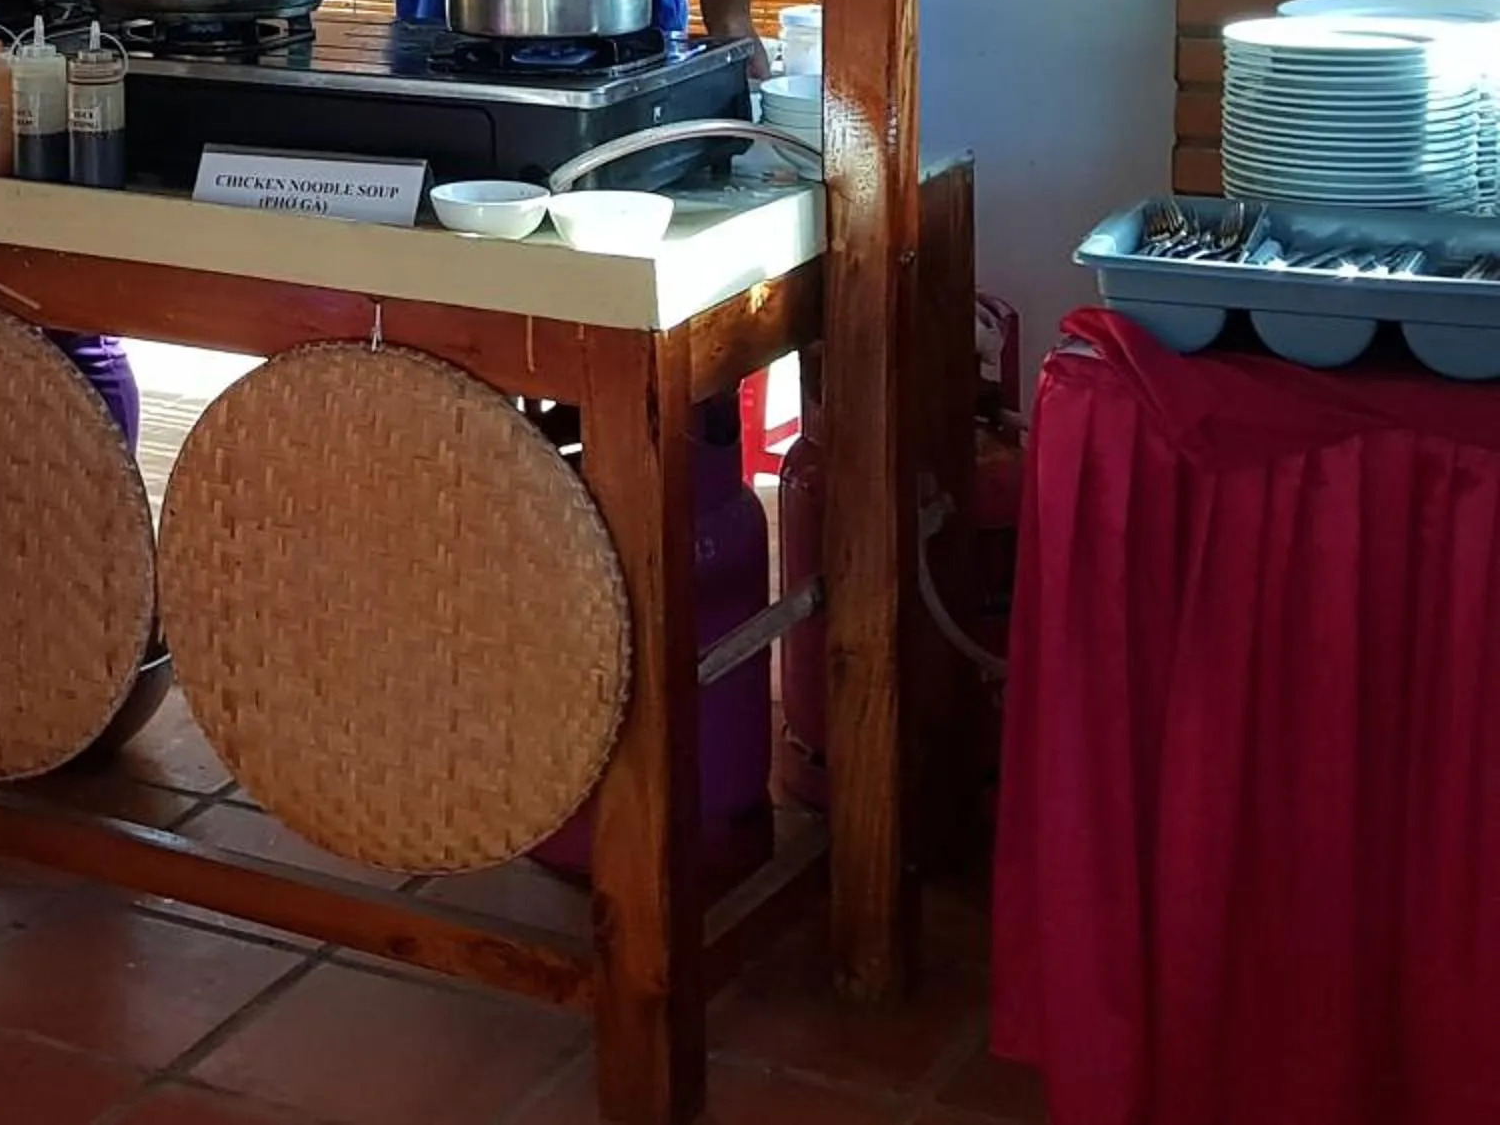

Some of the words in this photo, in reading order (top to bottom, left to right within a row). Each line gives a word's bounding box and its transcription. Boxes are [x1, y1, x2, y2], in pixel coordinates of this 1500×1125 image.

[215, 174, 285, 191] CHICKEN
[287, 178, 354, 196] NOODLE
[356, 183, 399, 199] SOUP
